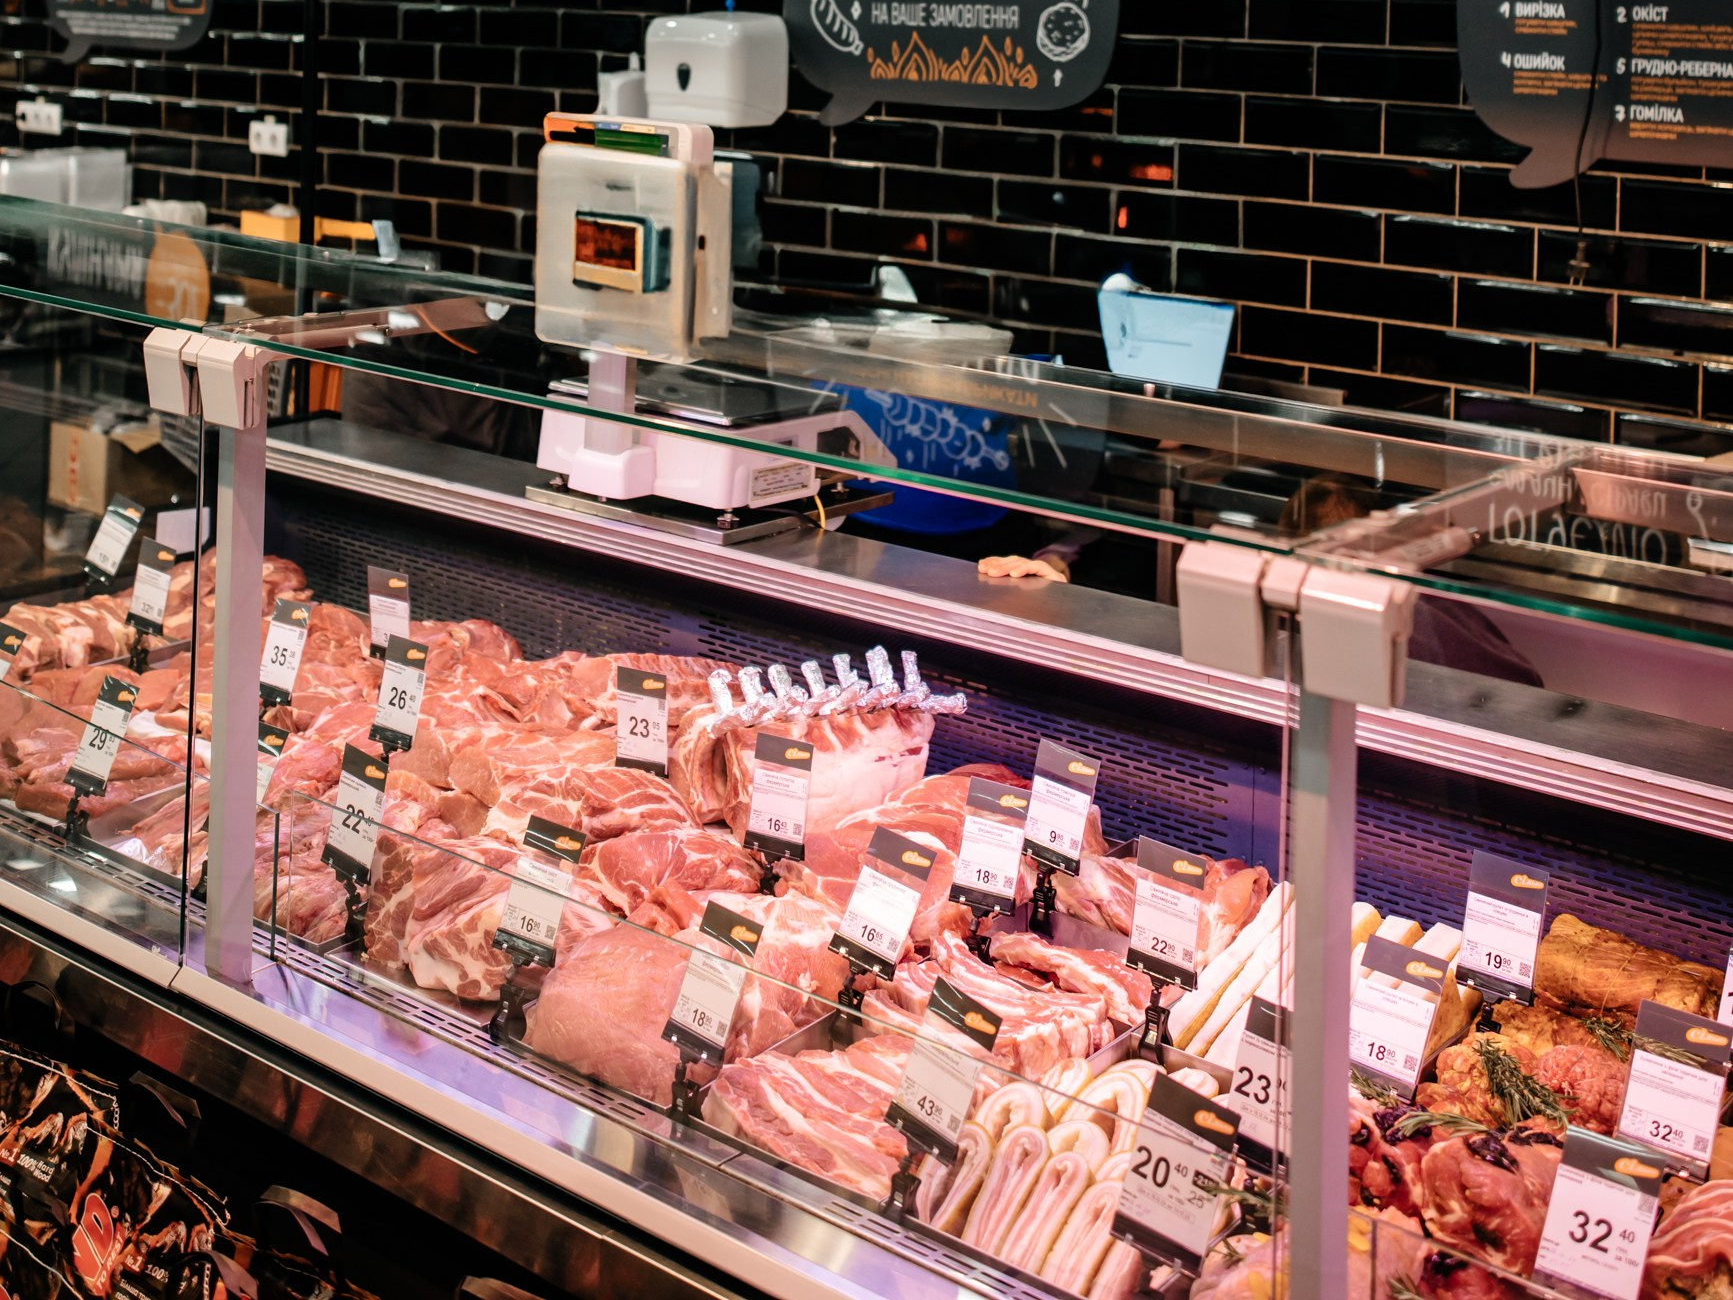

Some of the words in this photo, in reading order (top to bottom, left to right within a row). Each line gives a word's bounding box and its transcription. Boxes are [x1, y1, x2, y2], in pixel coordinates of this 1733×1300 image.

[871, 3, 889, 24] НА
[891, 3, 926, 26] ВАШЕ
[929, 4, 1020, 29] ЗАМОВЛЕННЯ
[1499, 1, 1510, 18] 1
[1515, 0, 1565, 18] ВИРІЗКА
[1616, 6, 1627, 23] 2
[1632, 3, 1669, 22] ОКІСТ
[1514, 52, 1565, 71] ОШИЙОК
[1630, 104, 1684, 123] ГОМІЛКА
[271, 646, 288, 667] 35
[388, 686, 407, 710] 26
[629, 716, 650, 739] 23
[89, 727, 108, 751] 29
[342, 804, 365, 834] 22
[768, 817, 781, 832] 16
[1050, 830, 1057, 843] 9
[976, 868, 990, 884] 18
[520, 915, 533, 933] 16
[861, 924, 877, 942] 16
[1151, 936, 1168, 955] 22
[1167, 943, 1175, 951] 90
[1485, 951, 1502, 969] 19
[1502, 957, 1511, 966] 90
[692, 1008, 706, 1027] 18
[1367, 1041, 1386, 1061] 18
[1386, 1048, 1396, 1058] 90
[1234, 1066, 1272, 1105] 23
[917, 1095, 935, 1117] 43
[1649, 1120, 1673, 1142] 32
[1672, 1128, 1684, 1139] 40
[17, 1153, 38, 1172] 100%
[37, 1161, 55, 1174] Hard
[1131, 1145, 1171, 1189] 20
[1174, 1163, 1188, 1178] 40
[33, 1168, 52, 1183] Wood
[1568, 1210, 1612, 1253] 32
[1619, 1229, 1635, 1243] 40
[145, 1264, 169, 1283] 100%
